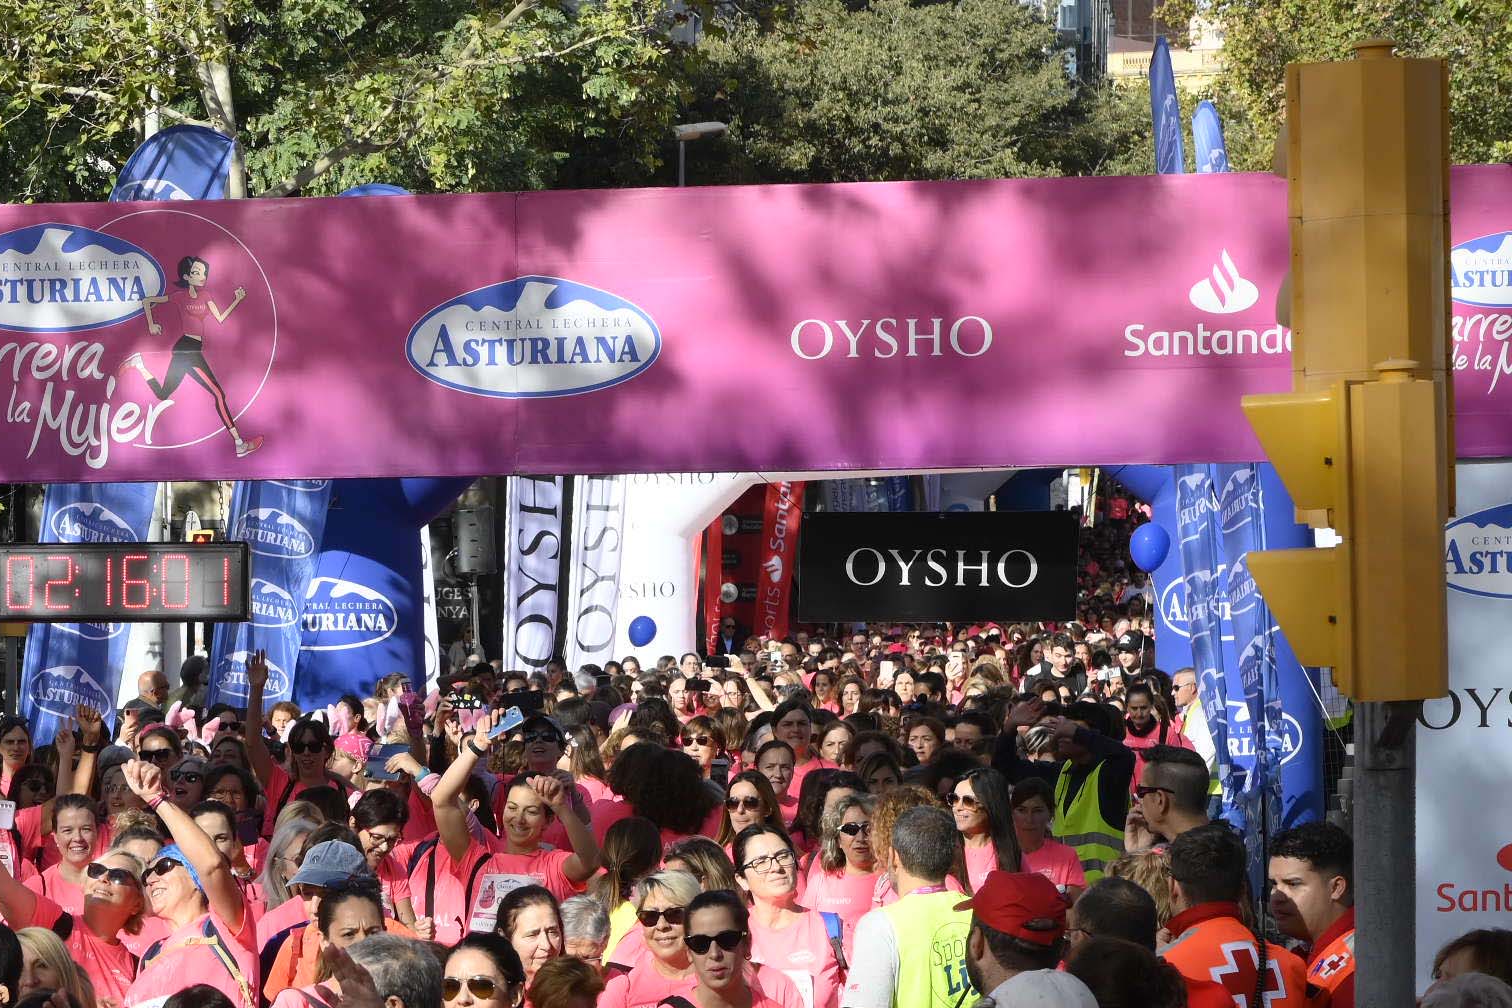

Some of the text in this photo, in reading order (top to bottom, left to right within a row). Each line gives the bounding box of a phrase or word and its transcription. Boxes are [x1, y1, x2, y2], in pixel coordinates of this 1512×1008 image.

[68, 259, 142, 271] LECHERA
[464, 317, 634, 332] CENTRAL LECHERA
[790, 315, 994, 360] OYSHO
[1123, 322, 1292, 358] Santand
[1451, 313, 1512, 342] arre
[425, 322, 642, 368] ASTURIANA
[5, 383, 32, 424] la
[25, 377, 176, 470] Mujer
[515, 476, 560, 668] OYSH
[575, 477, 621, 653] OYSH
[845, 547, 1039, 588] OYSHO
[252, 600, 293, 622] RIANA
[334, 602, 384, 611] LECHERA
[1416, 687, 1512, 731] OY
[944, 959, 981, 997] Li
